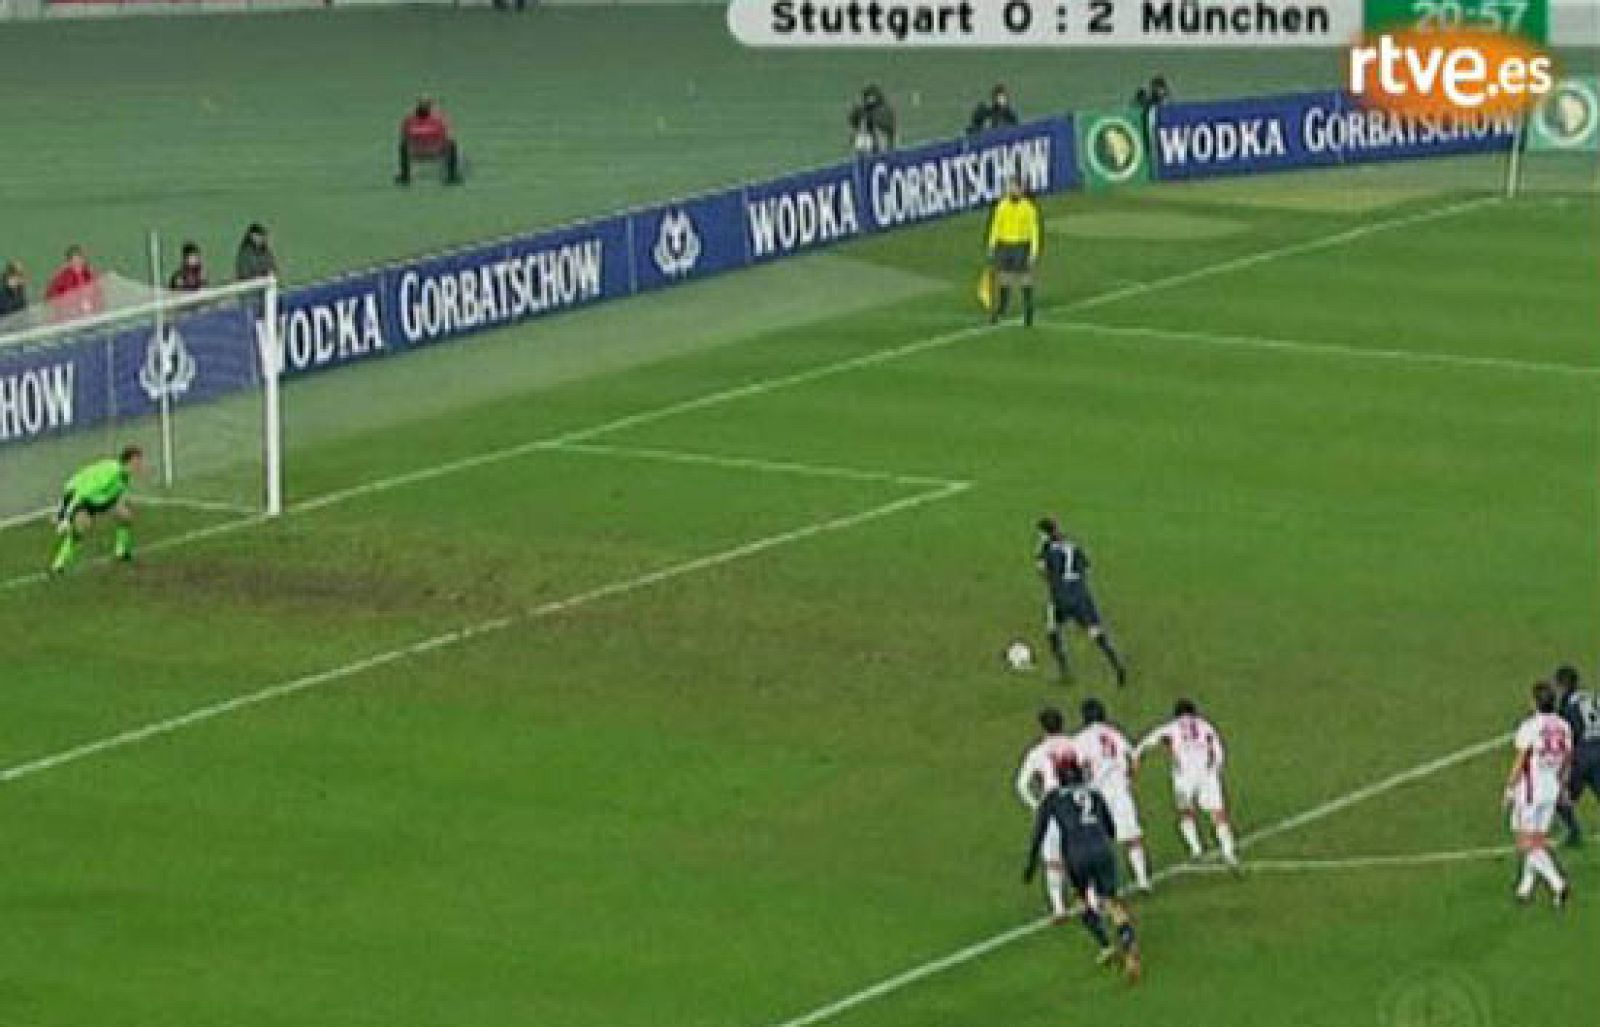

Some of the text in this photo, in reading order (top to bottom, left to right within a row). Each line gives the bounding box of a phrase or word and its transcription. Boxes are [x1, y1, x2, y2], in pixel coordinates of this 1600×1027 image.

[747, 135, 1051, 257] WODKA GORBATSCHOW
[1160, 118, 1287, 165] WODKA
[255, 238, 602, 376] WODKA GORBATSCHOW
